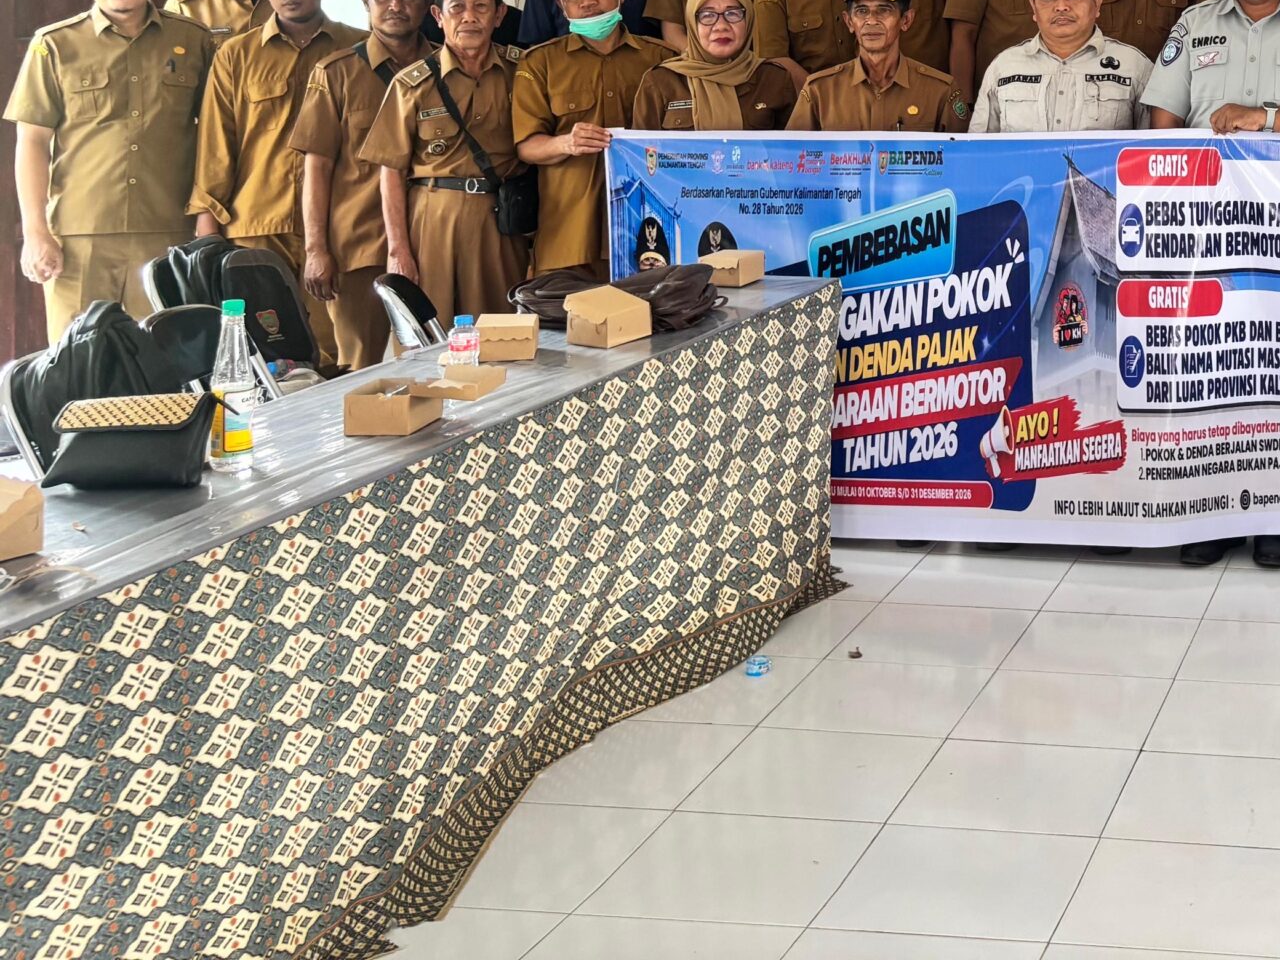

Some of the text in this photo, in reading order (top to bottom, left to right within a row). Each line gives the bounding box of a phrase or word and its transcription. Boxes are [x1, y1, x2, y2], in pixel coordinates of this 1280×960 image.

[1192, 36, 1226, 49] ENRICO
[889, 151, 943, 165] BAPENDA
[1148, 154, 1188, 177] GRATIS
[681, 187, 861, 202] Berdasarkan Peraturan Gubernur Kalimantan Tengah
[739, 203, 803, 215] No. 28 Tahun 2026
[1146, 201, 1185, 226] BEBAS
[1189, 201, 1264, 226] TUNGGAKAN
[819, 207, 950, 277] PEMBEBASAN
[926, 262, 1013, 323] POKOK
[1148, 286, 1189, 309] GRATIS
[1146, 325, 1181, 347] BEBAS
[1185, 323, 1221, 346] POKOK
[1225, 321, 1246, 343] PKB
[1250, 321, 1272, 342] DAN
[849, 340, 915, 381] DENDA
[915, 326, 978, 369] PAJAK
[1146, 353, 1178, 375] BALIK
[1181, 351, 1213, 374] NAMA
[1216, 348, 1254, 371] MUTASI
[900, 367, 1006, 418] BERMOTOR
[1146, 381, 1172, 403] DARI
[1176, 379, 1204, 402] LUAR
[1207, 374, 1256, 400] PROVINSI
[1016, 411, 1049, 443] AYO
[1132, 421, 1280, 446] Biaya yang harus tetap dibayarkan
[843, 421, 958, 473] TAHUN 2026
[1015, 432, 1122, 472] MANFAATKAN SEGERA
[1178, 448, 1184, 460] &
[1186, 446, 1214, 459] DENDA
[1216, 441, 1257, 455] BERJALAN
[1201, 461, 1235, 475] NEGARA
[1237, 458, 1266, 471] BUKAN
[837, 486, 857, 496] MULAI
[858, 487, 865, 497] 01
[866, 487, 897, 498] OKTOBER
[898, 488, 909, 500] S/D
[911, 489, 919, 498] 31
[919, 489, 954, 499] DESEMBER
[955, 489, 972, 500] 2026
[1054, 495, 1229, 518] INFO LEBIH LANJUT SILAHKAN HUBUNGI
